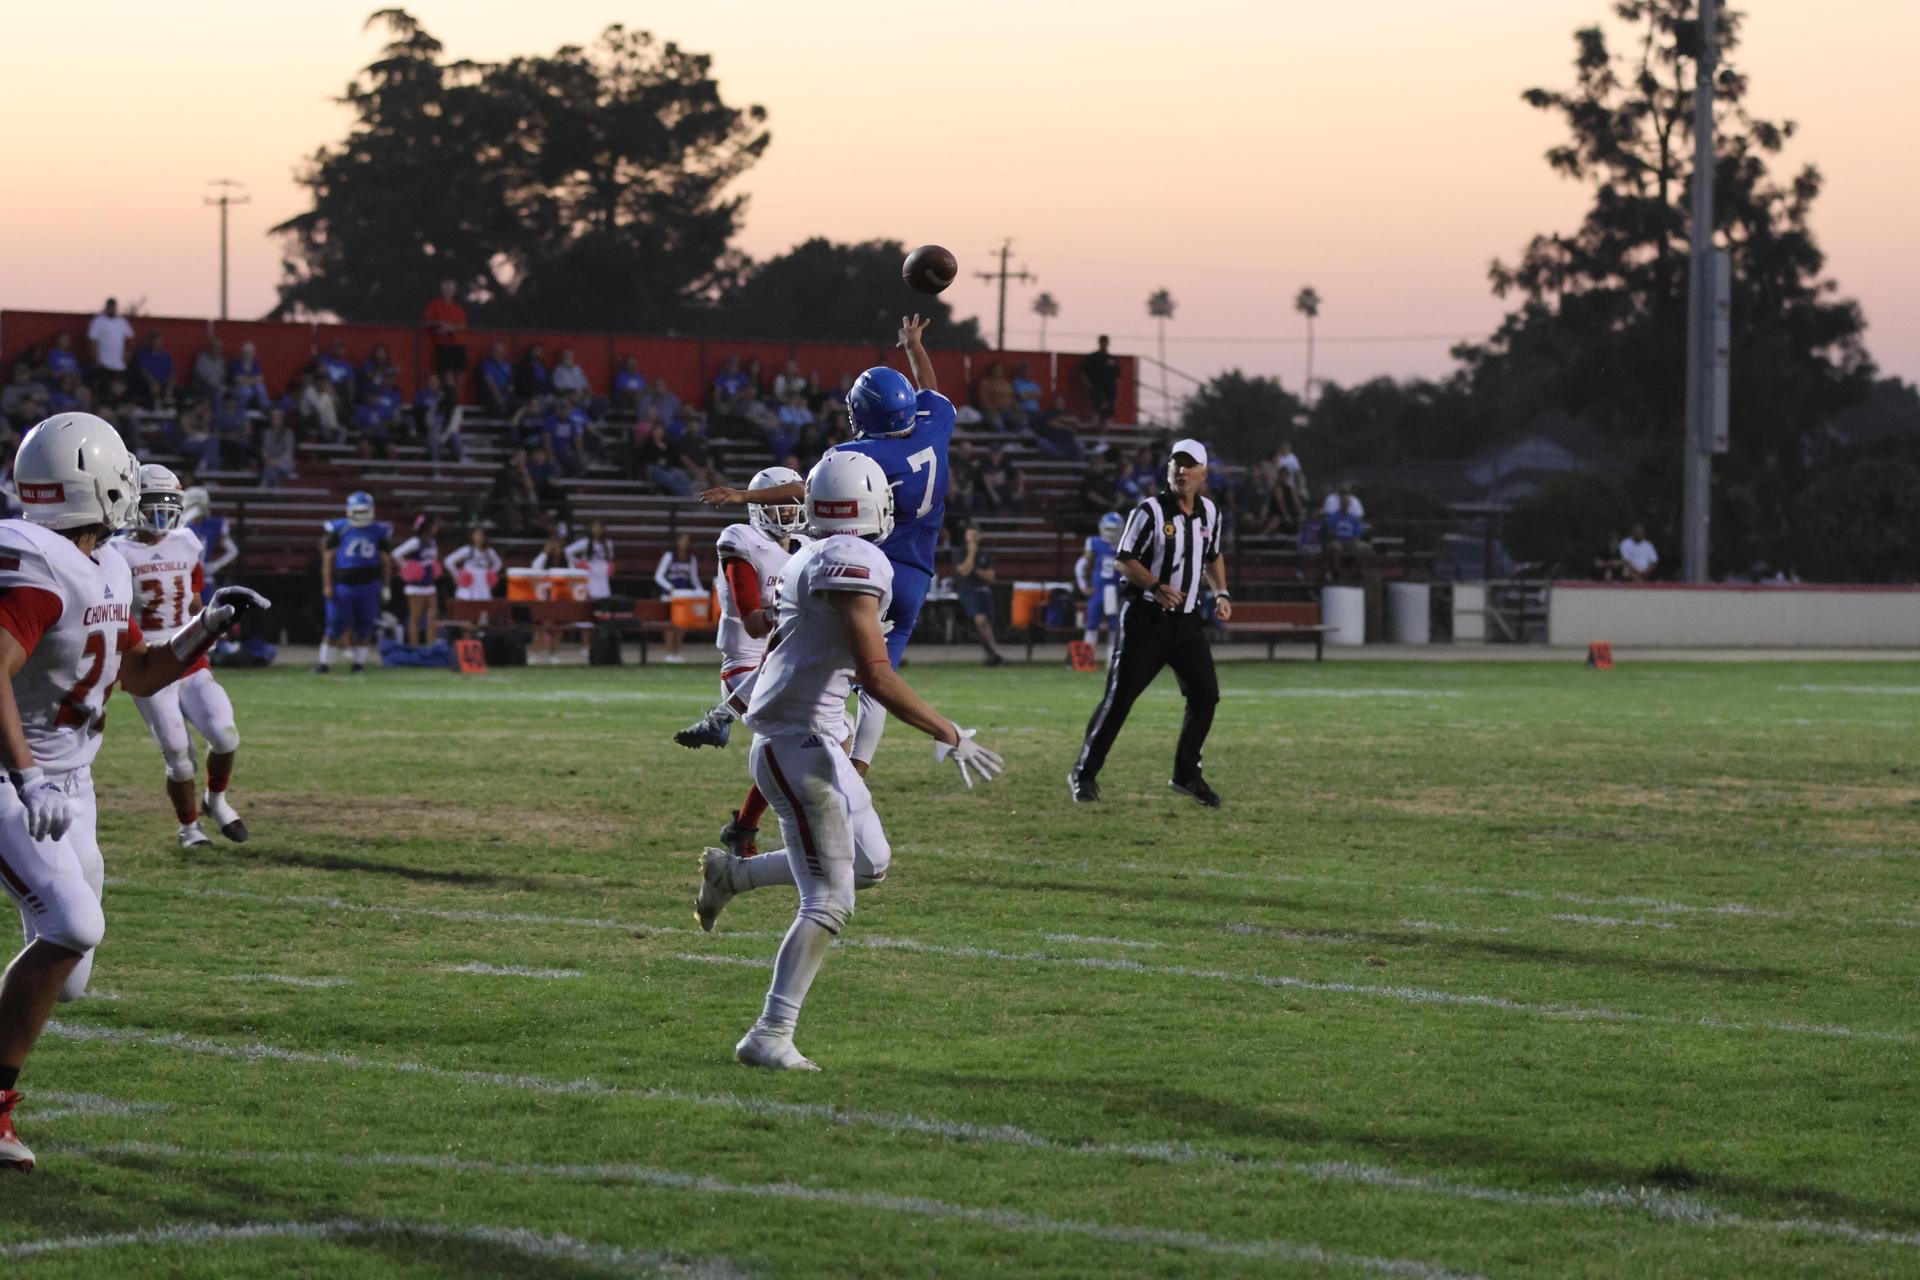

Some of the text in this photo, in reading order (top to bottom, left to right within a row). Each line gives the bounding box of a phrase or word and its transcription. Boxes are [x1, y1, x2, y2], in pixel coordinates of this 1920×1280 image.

[906, 446, 937, 518] 7
[131, 560, 187, 577] CHOWCHILLA
[83, 603, 129, 626] CHOWCHILL
[140, 575, 184, 631] 21
